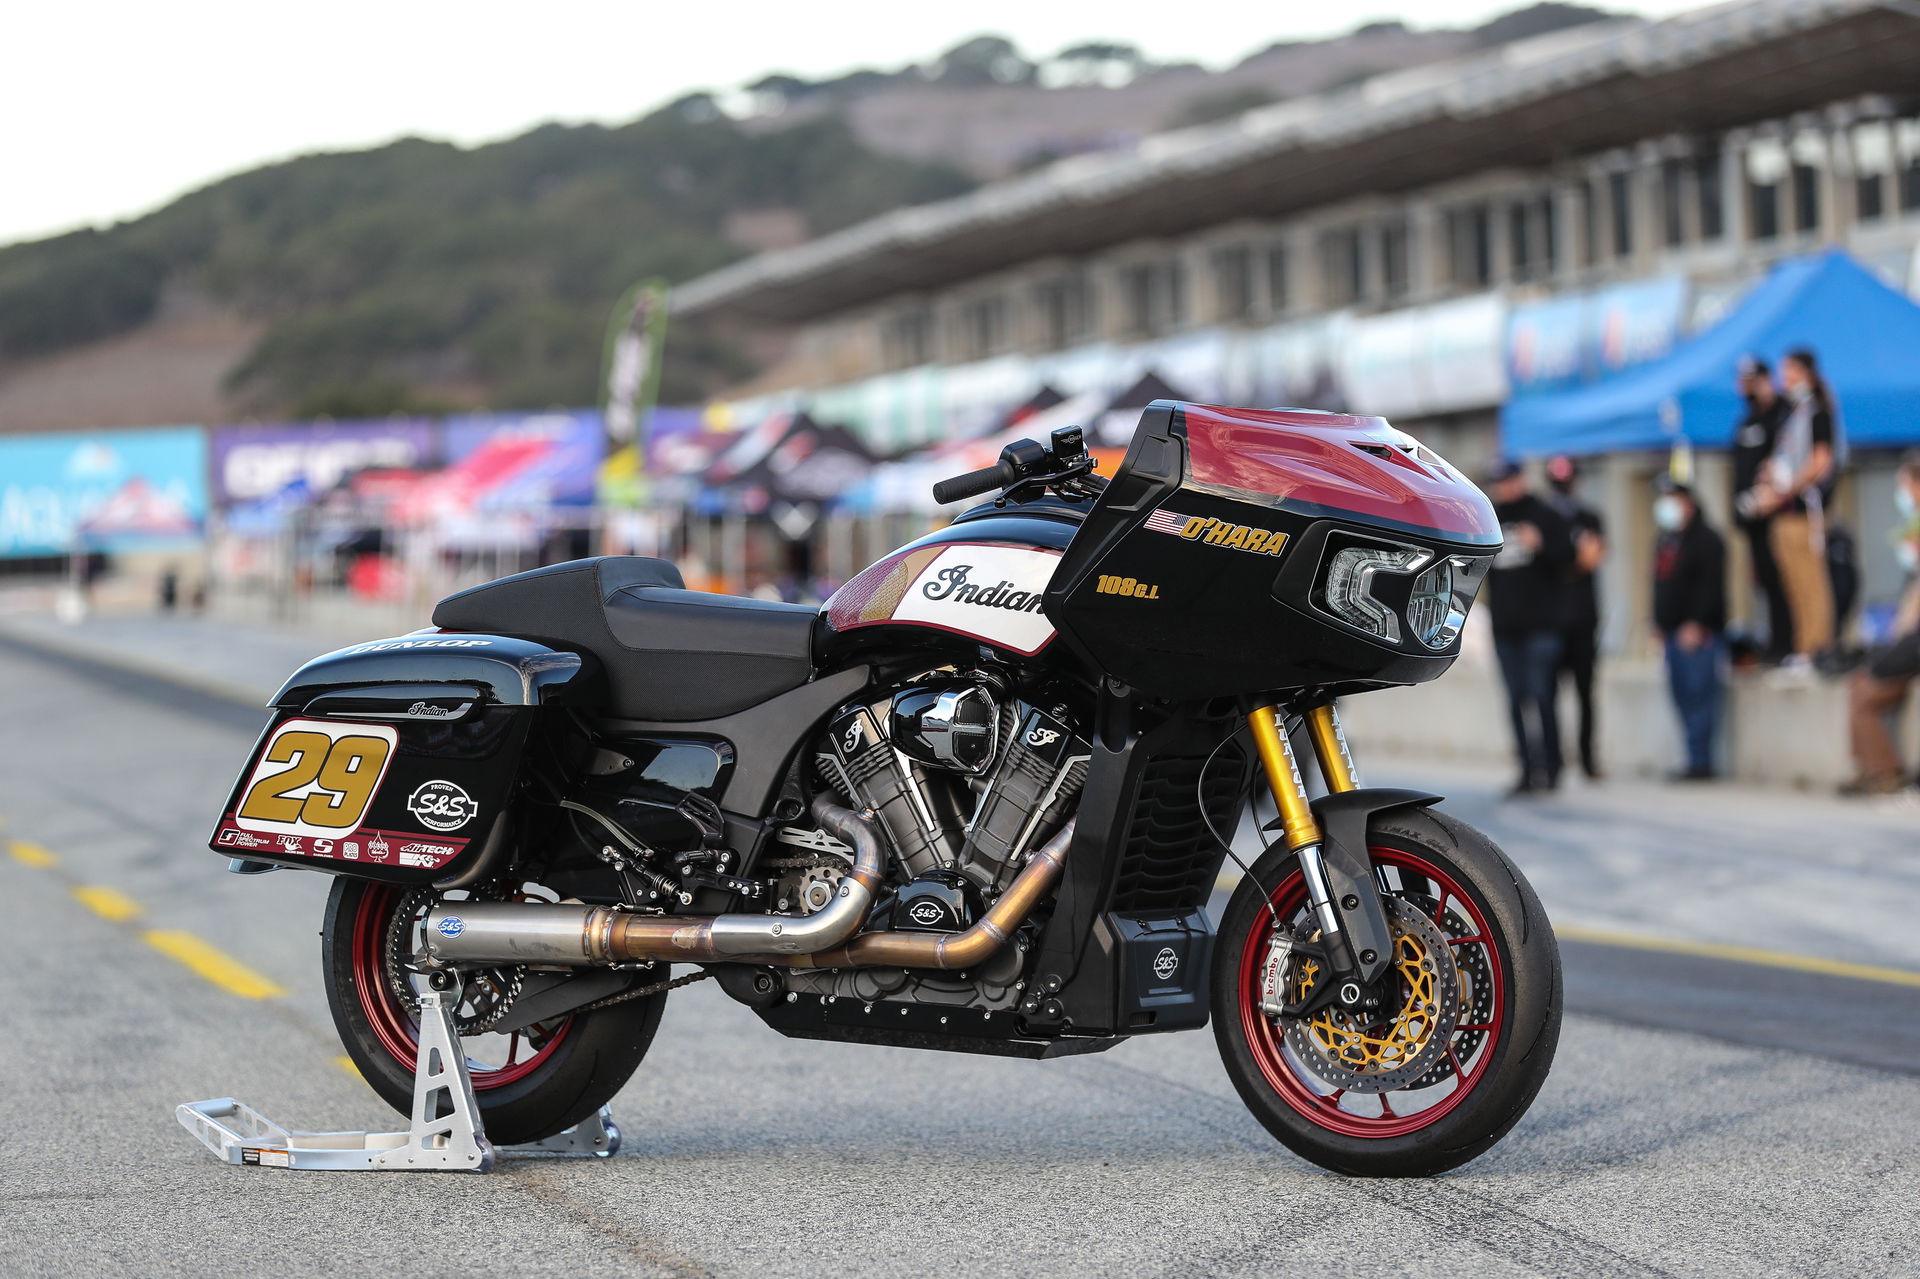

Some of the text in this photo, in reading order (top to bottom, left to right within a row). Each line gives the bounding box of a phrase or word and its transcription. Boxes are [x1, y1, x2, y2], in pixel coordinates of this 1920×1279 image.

[1180, 517, 1290, 557] O'HARA
[923, 565, 1043, 614] Indian
[345, 640, 493, 656] DUNLOP
[408, 702, 448, 717] Indian
[237, 731, 390, 828] 29
[430, 784, 454, 792] PROVEN
[423, 816, 463, 828] PERFORMANCE
[238, 836, 270, 845] SPECTRUM
[276, 834, 303, 849] FOX
[915, 908, 937, 918] S&S
[440, 922, 462, 931] S&S
[1156, 956, 1174, 970] S&S
[1266, 957, 1279, 995] brembo
